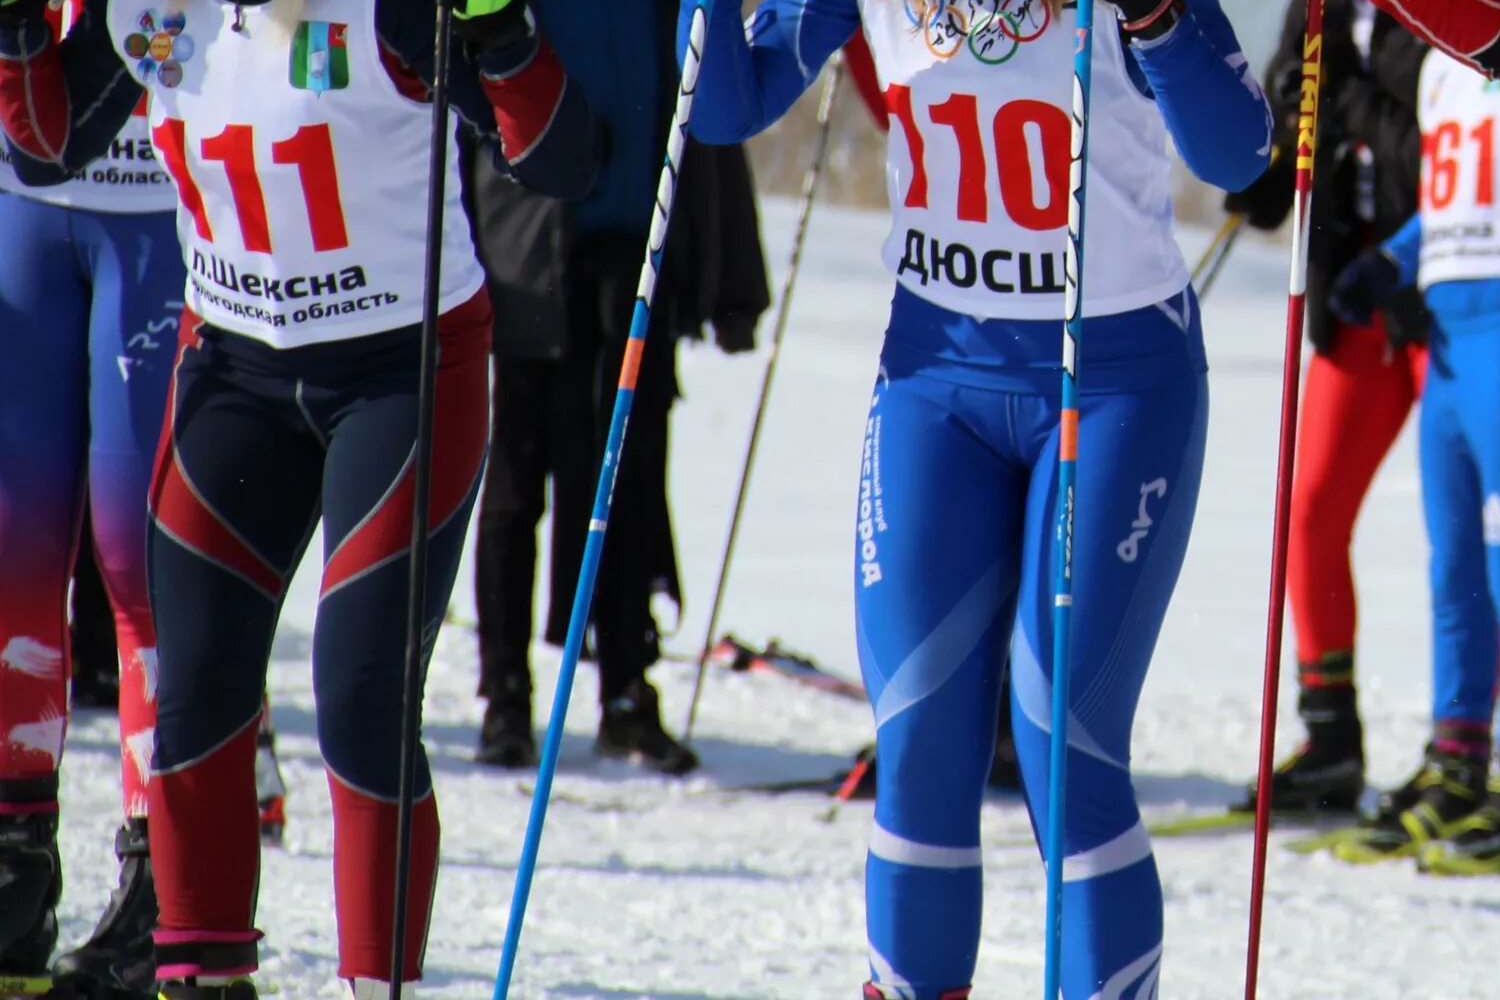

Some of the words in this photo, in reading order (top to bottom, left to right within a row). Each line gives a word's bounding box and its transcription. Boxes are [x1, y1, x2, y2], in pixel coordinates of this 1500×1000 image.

[152, 117, 349, 255] 111
[882, 83, 1072, 231] 110
[193, 247, 367, 301] п.Шексна
[897, 228, 1067, 295] ДЮСШ
[293, 292, 399, 324] область
